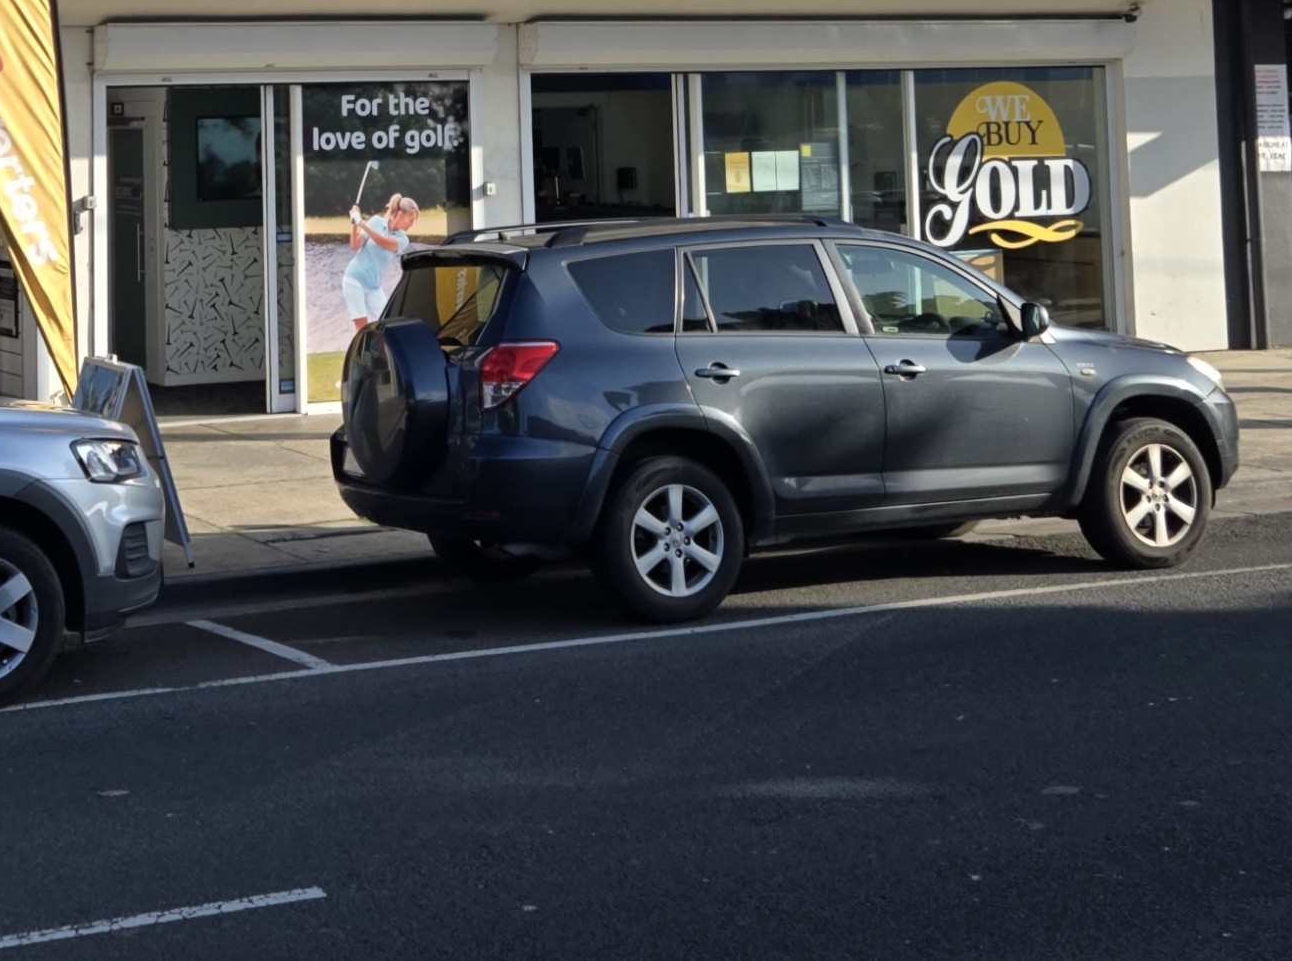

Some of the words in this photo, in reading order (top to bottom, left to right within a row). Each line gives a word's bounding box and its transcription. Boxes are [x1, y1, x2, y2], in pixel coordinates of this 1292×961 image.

[341, 94, 382, 117] For
[389, 92, 430, 116] the
[975, 93, 1032, 122] WE
[312, 126, 366, 151] love
[372, 125, 400, 150] of
[404, 123, 460, 154] golf.
[976, 119, 1044, 147] BUY
[925, 132, 1093, 248] GOLD
